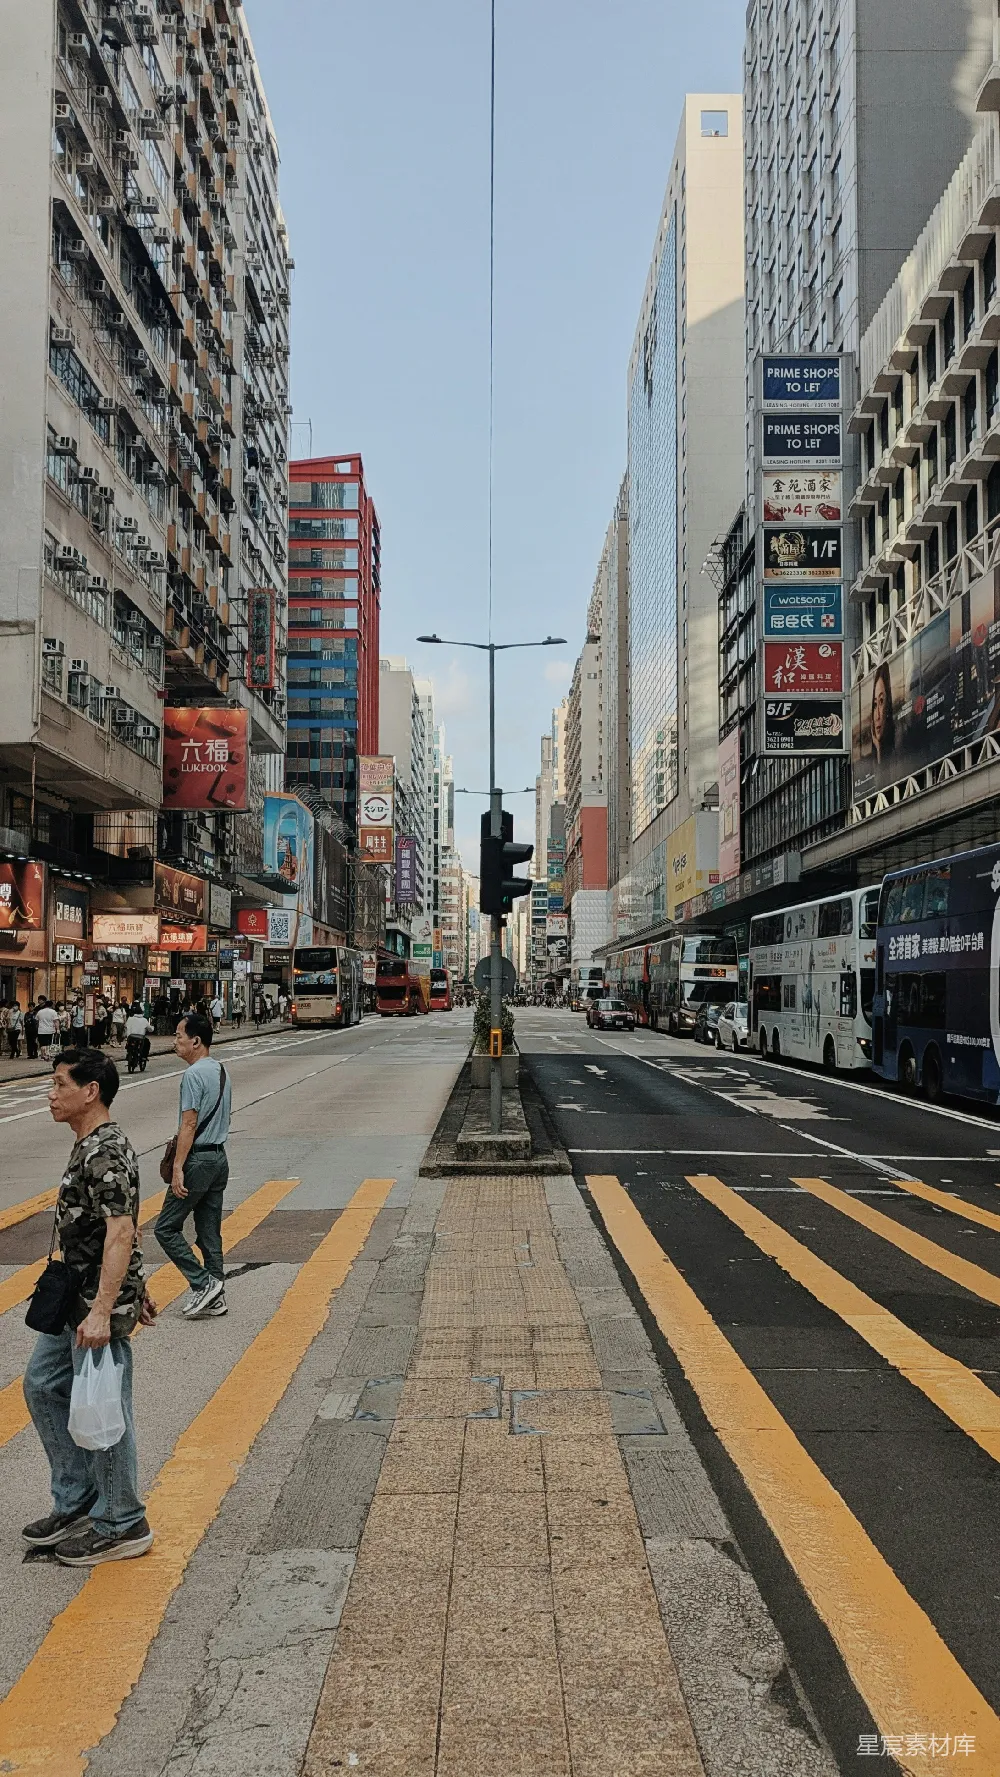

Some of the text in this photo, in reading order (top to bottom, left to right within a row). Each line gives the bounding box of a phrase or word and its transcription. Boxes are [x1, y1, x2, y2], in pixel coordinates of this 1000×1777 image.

[767, 367, 840, 379] PRIME SHOPS
[785, 382, 821, 393] TO LET
[767, 424, 840, 435] PRIME SHOPS
[786, 438, 822, 449] TO LET
[772, 479, 832, 493] 金苑酒家
[792, 503, 812, 518] 4F
[811, 540, 838, 558] 1/F
[778, 595, 827, 604] watsons
[770, 614, 815, 629] 屈臣氏
[766, 703, 792, 716] 5/F
[181, 739, 228, 763] 六福
[181, 763, 228, 773] LUKFOOK
[363, 806, 390, 814] スシロー
[365, 835, 387, 848] 周生生
[401, 849, 411, 889] 龍豐集團
[162, 932, 194, 941] 六福珠寶
[889, 933, 921, 961] 全港首家
